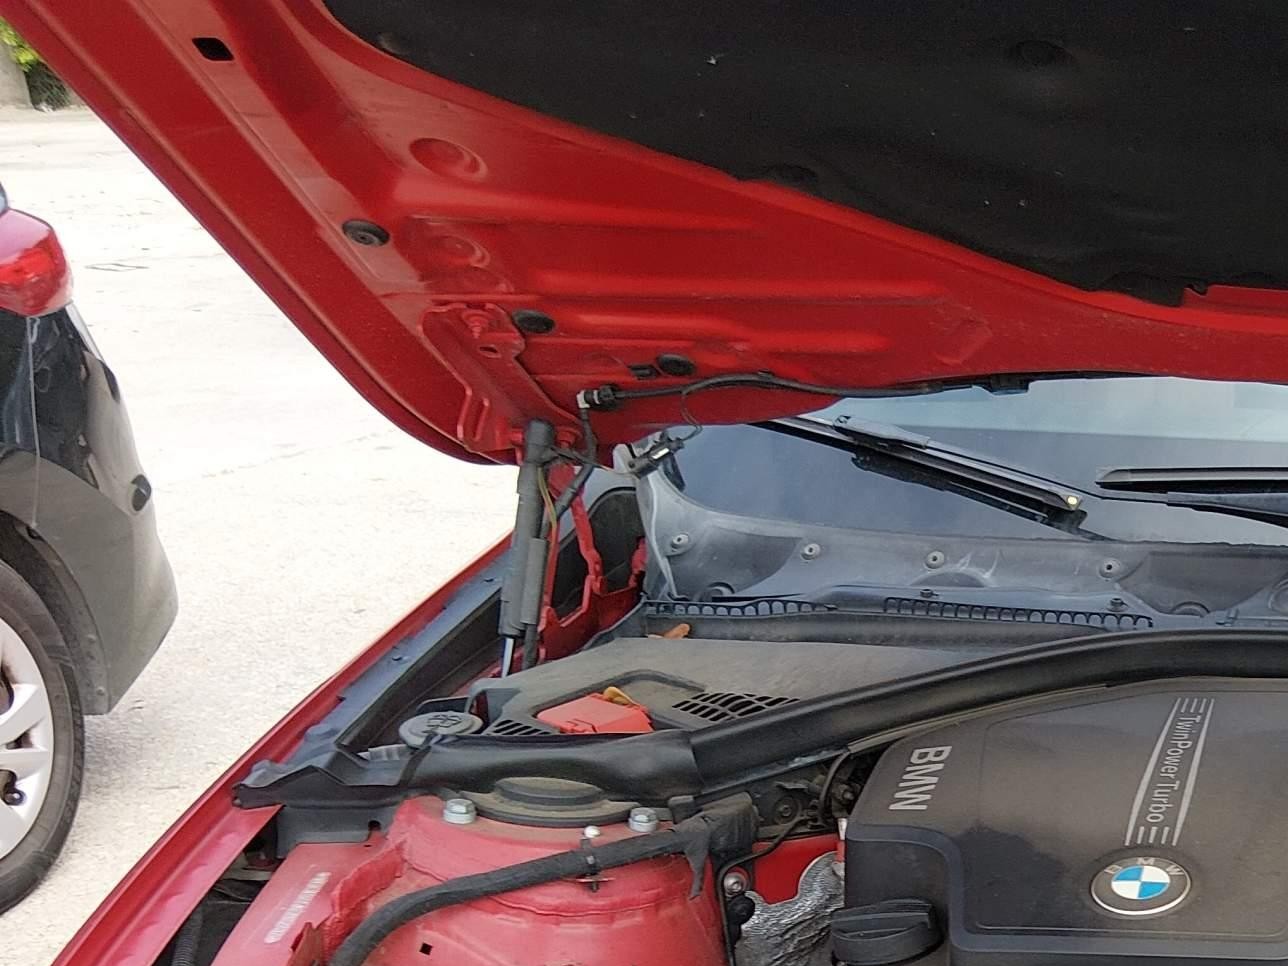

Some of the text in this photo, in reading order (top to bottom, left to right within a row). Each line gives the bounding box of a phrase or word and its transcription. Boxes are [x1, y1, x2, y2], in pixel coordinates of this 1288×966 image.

[889, 746, 952, 810] BMW
[1145, 715, 1201, 823] TwinPower Turbo
